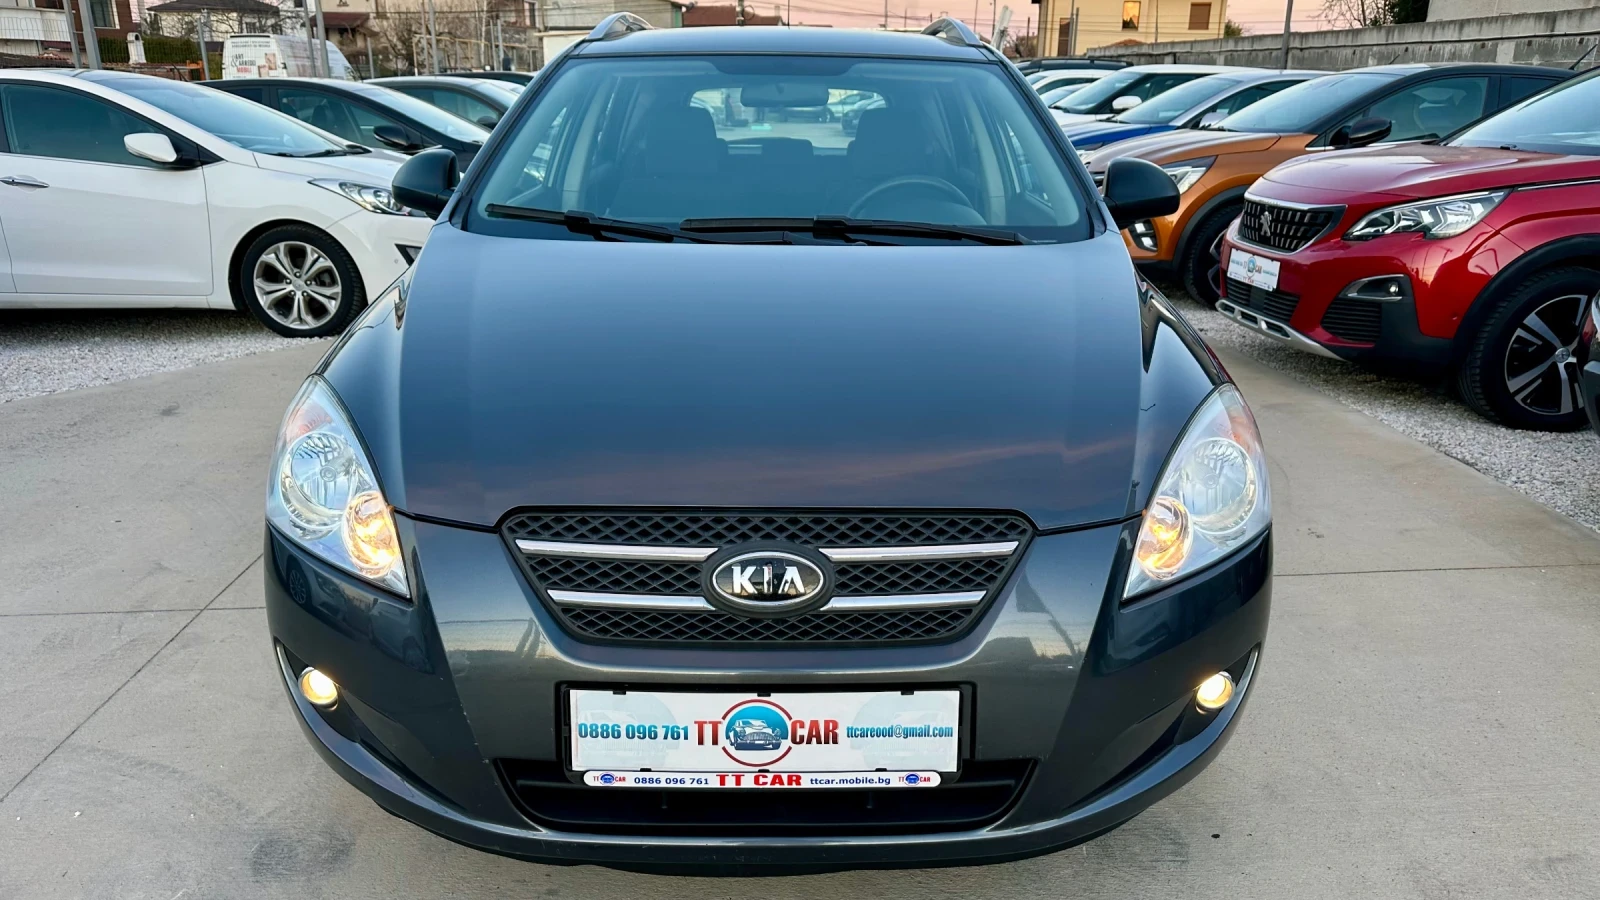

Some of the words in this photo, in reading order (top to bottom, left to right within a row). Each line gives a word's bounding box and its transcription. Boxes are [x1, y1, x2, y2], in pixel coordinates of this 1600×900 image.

[731, 565, 806, 594] KIA
[578, 722, 621, 739] 0886
[625, 724, 659, 740] 096
[662, 725, 689, 741] 761
[694, 720, 723, 746] TT
[790, 719, 839, 745] CAR
[846, 724, 954, 739] ttcareood@gmail.com
[614, 775, 626, 783] CAR
[634, 777, 662, 785] 0886
[665, 777, 686, 785] 096
[689, 777, 709, 785] 761
[716, 774, 745, 787] TT
[753, 774, 803, 787] CAR
[810, 776, 891, 785] ttcar.mobile.bg
